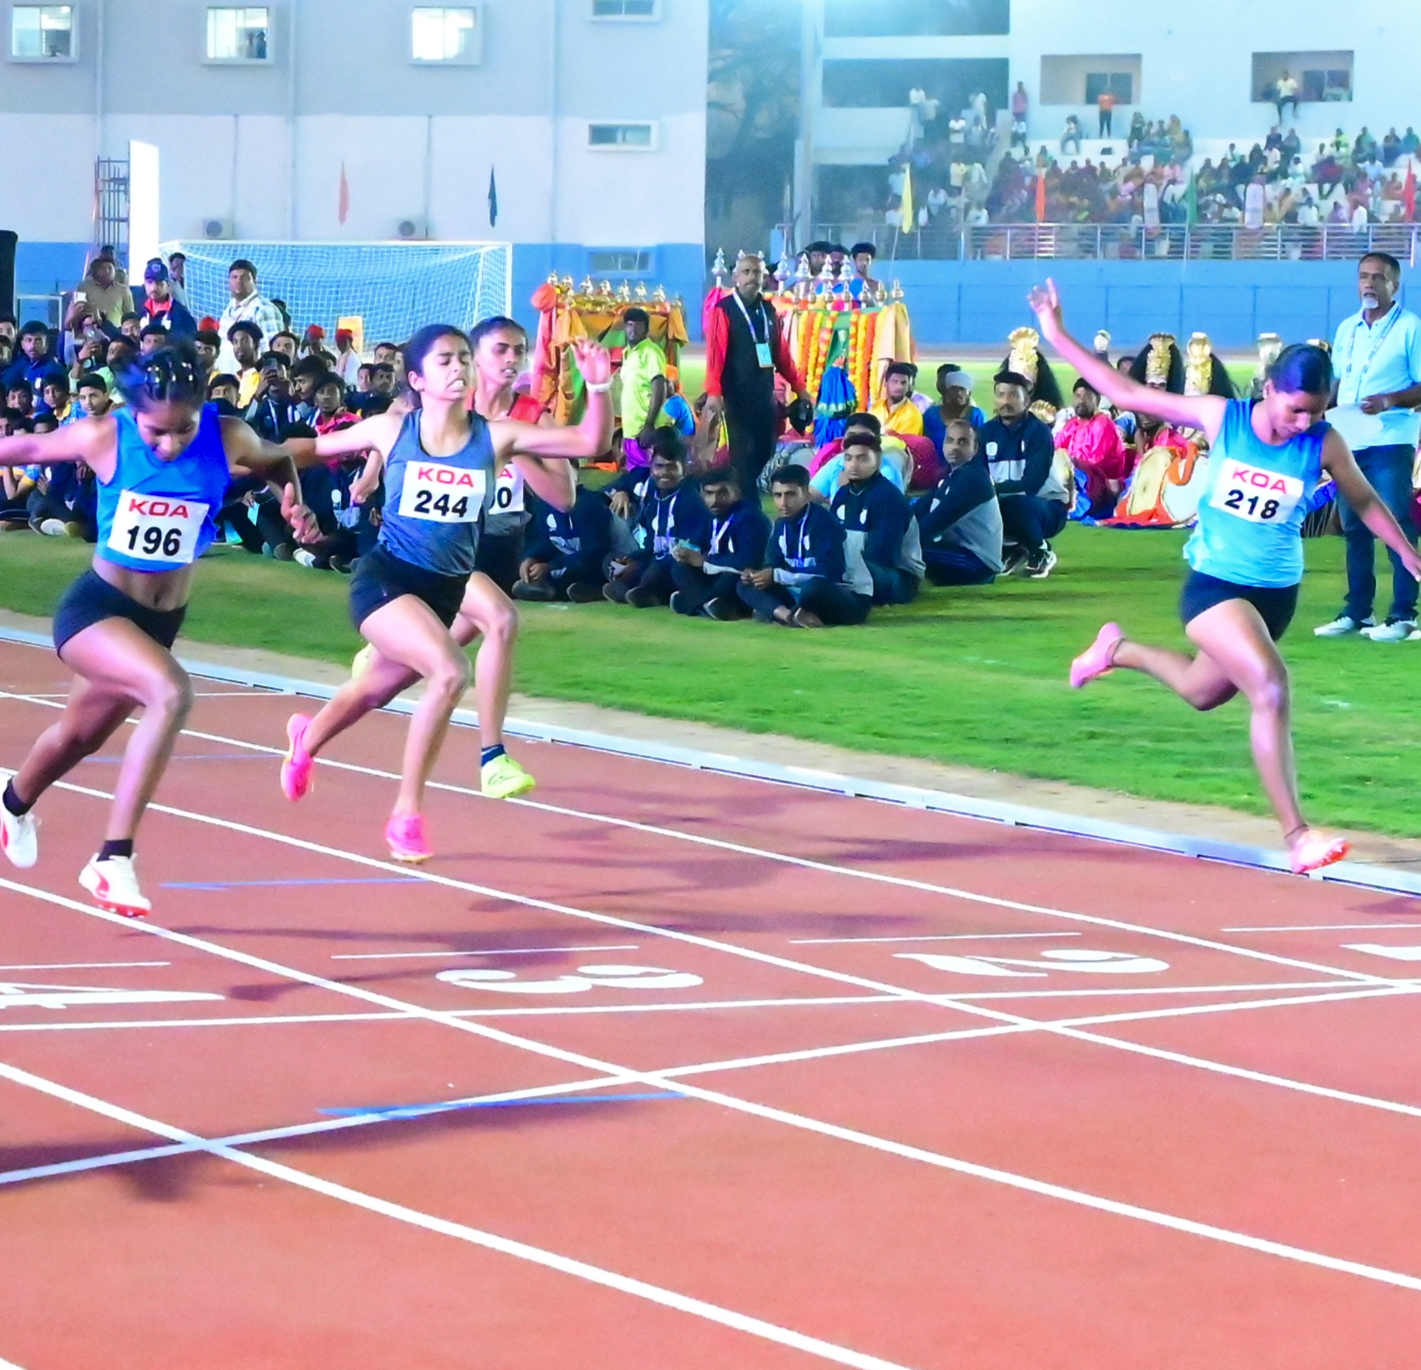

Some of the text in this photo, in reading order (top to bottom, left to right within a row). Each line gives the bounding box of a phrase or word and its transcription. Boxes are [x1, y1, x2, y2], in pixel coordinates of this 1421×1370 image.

[418, 467, 474, 488] KOA
[1232, 467, 1287, 494] KOA
[128, 498, 188, 518] KOA
[414, 489, 469, 518] 244
[1224, 489, 1280, 519] 218
[127, 525, 182, 556] 196
